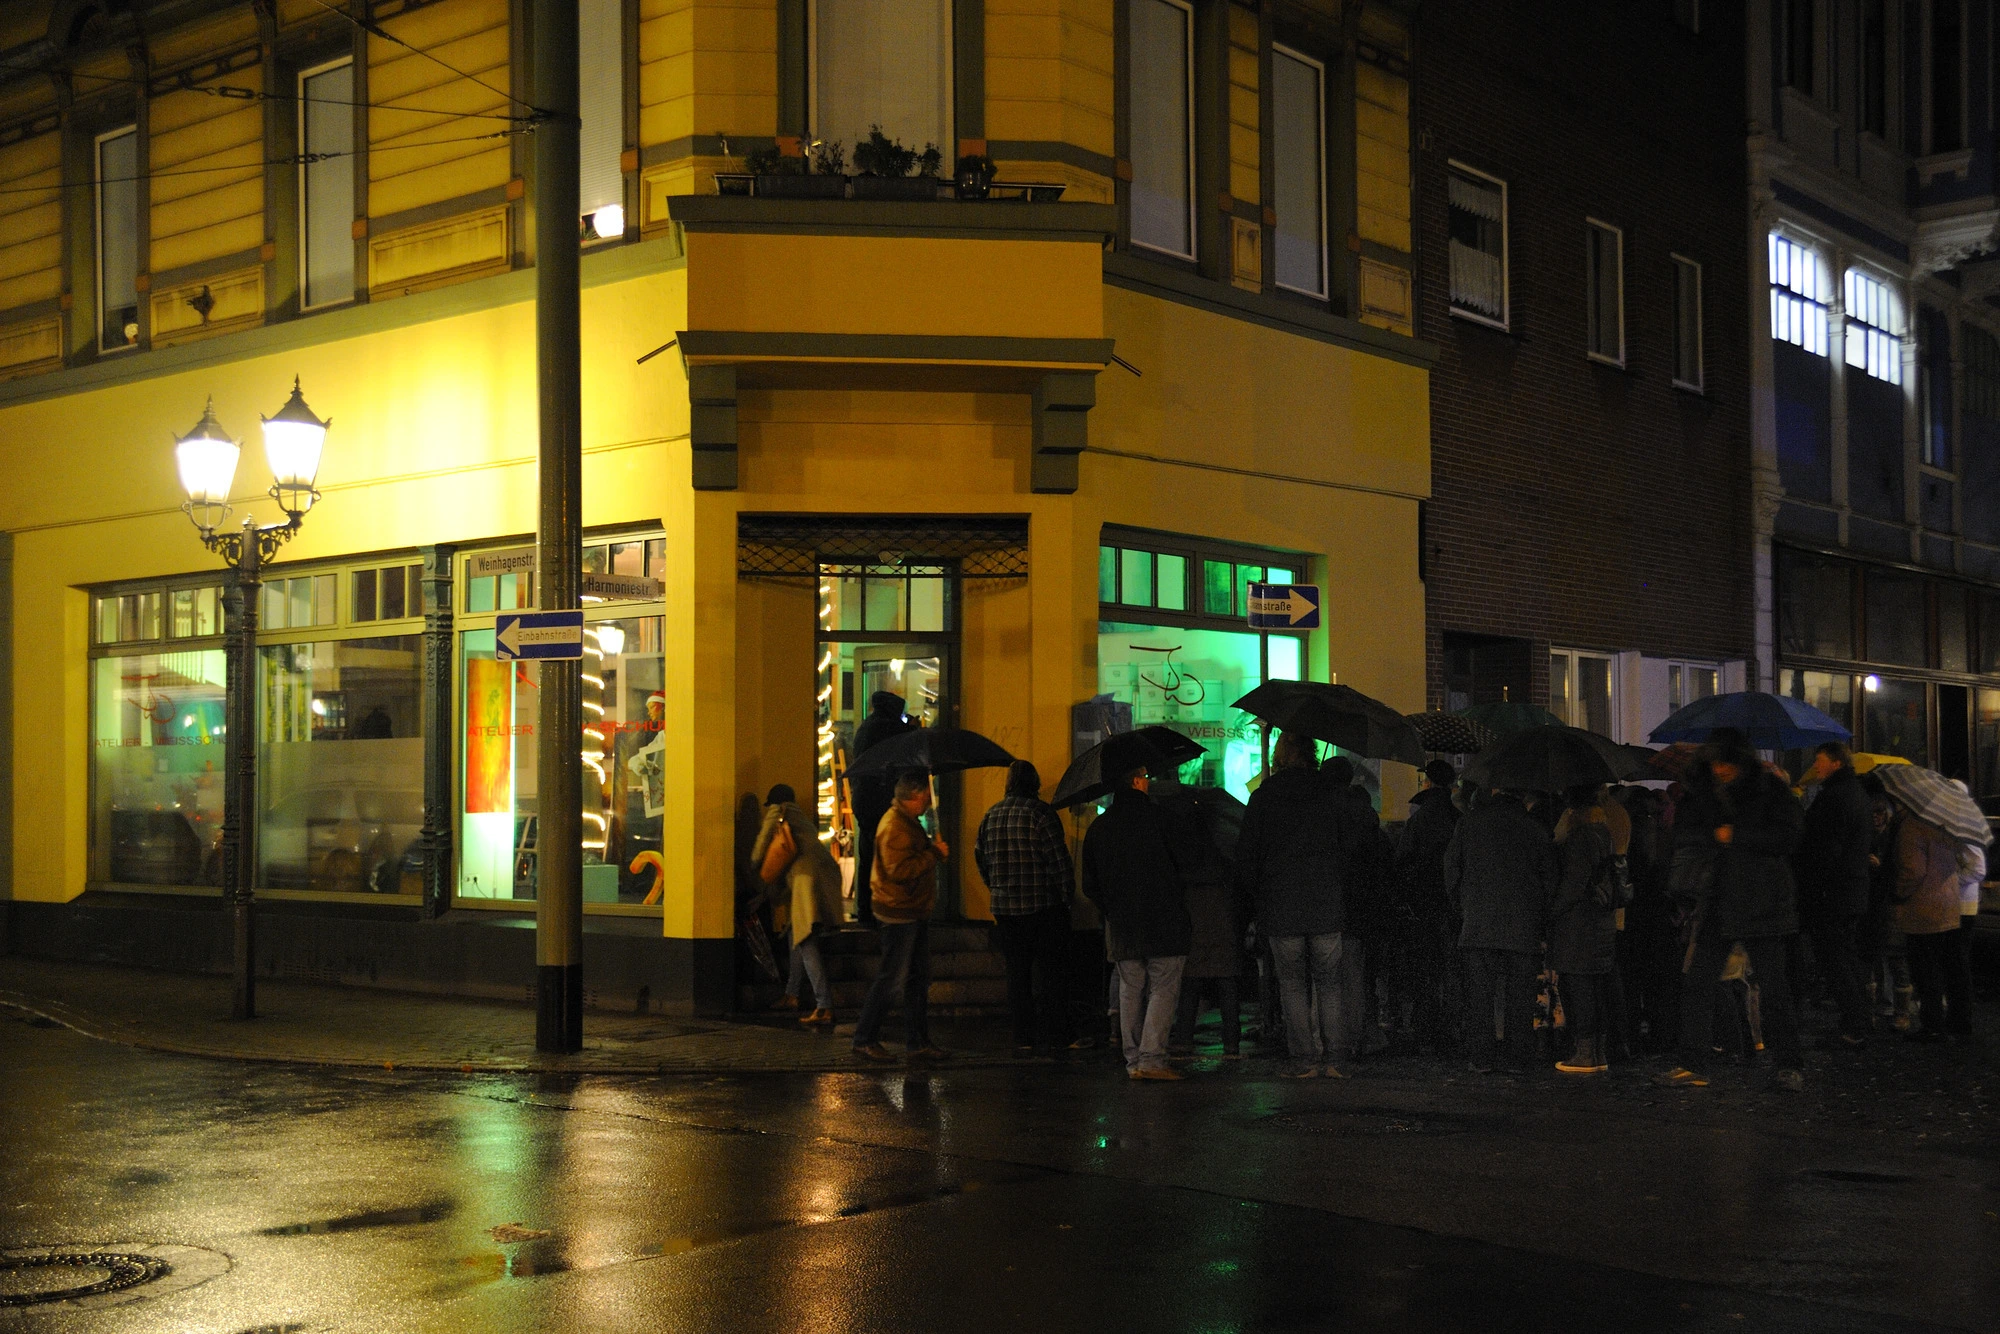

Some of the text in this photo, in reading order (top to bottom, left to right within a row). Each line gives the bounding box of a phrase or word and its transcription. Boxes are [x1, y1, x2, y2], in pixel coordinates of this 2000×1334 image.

[478, 553, 535, 573] Weinhagenstr.
[587, 577, 651, 597] Harmoniestr.
[517, 627, 577, 643] Einbahnstraße
[467, 724, 534, 737] ATELIER
[95, 737, 141, 748] ATELIER
